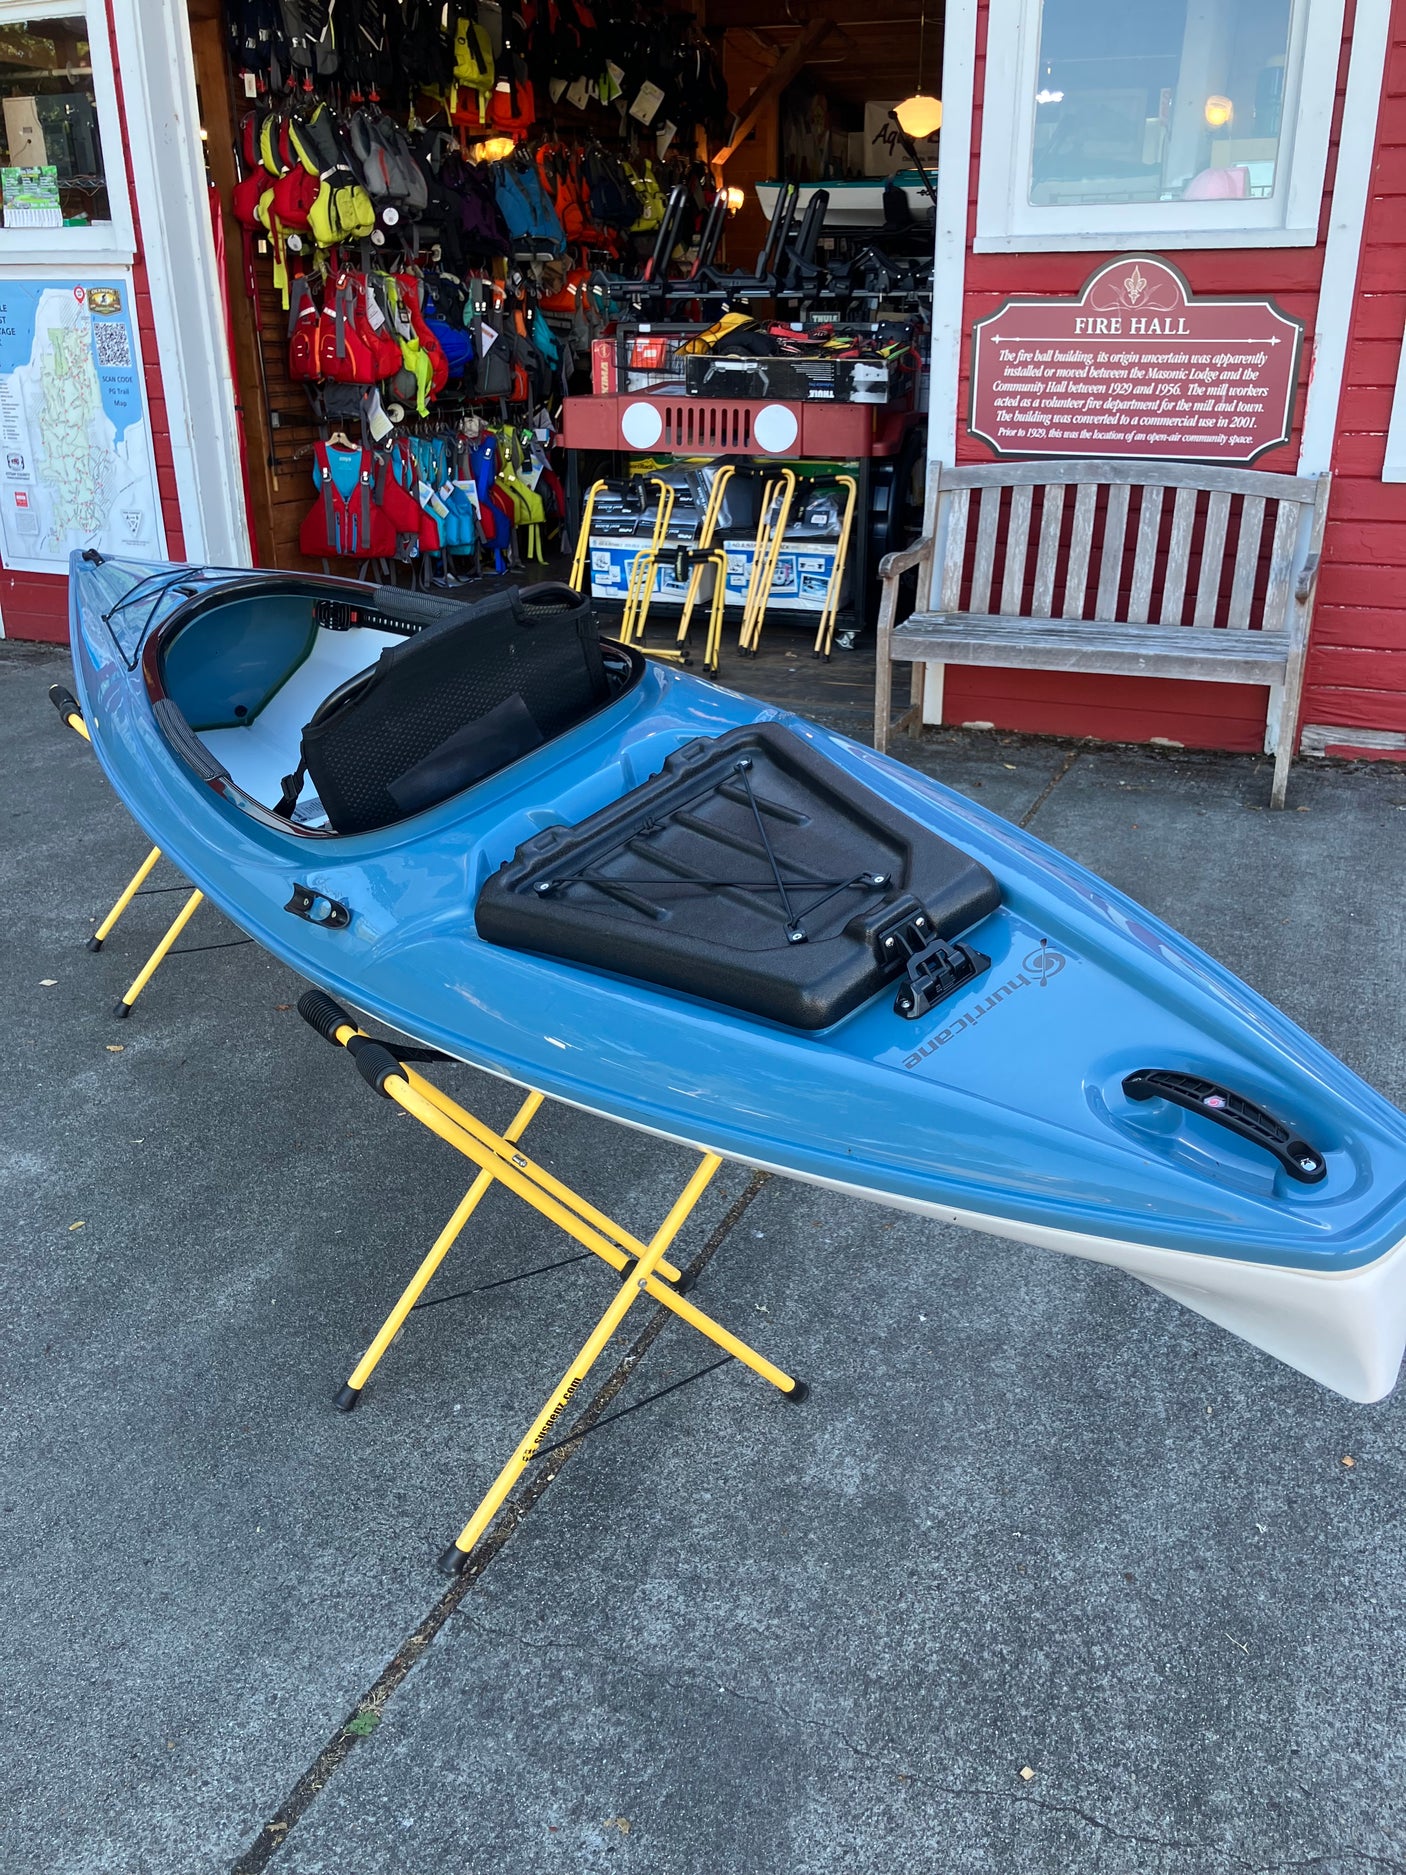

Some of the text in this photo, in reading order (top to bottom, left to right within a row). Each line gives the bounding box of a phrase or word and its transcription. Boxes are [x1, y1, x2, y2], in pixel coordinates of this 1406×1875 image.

[812, 314, 838, 323] THULE
[1074, 317, 1190, 335] FIRE HALL
[999, 349, 1268, 368] The fire hall building, its origin uncertain was apparently
[1004, 365, 1259, 383] installed or moved between the Masonic Lodge and the
[808, 390, 834, 398] THULE
[993, 380, 1269, 397] Community Hall between 1929 and 1956. The mill workers
[114, 400, 128, 409] Map
[994, 396, 1264, 413] acted as a volunteer fire department for the mill and town.
[996, 410, 1258, 428] The building was converted to a commercial use in 2001.
[998, 427, 1254, 446] Prior to 1929, this was the location of an open-air community space.
[902, 974, 1032, 1070] hurricane
